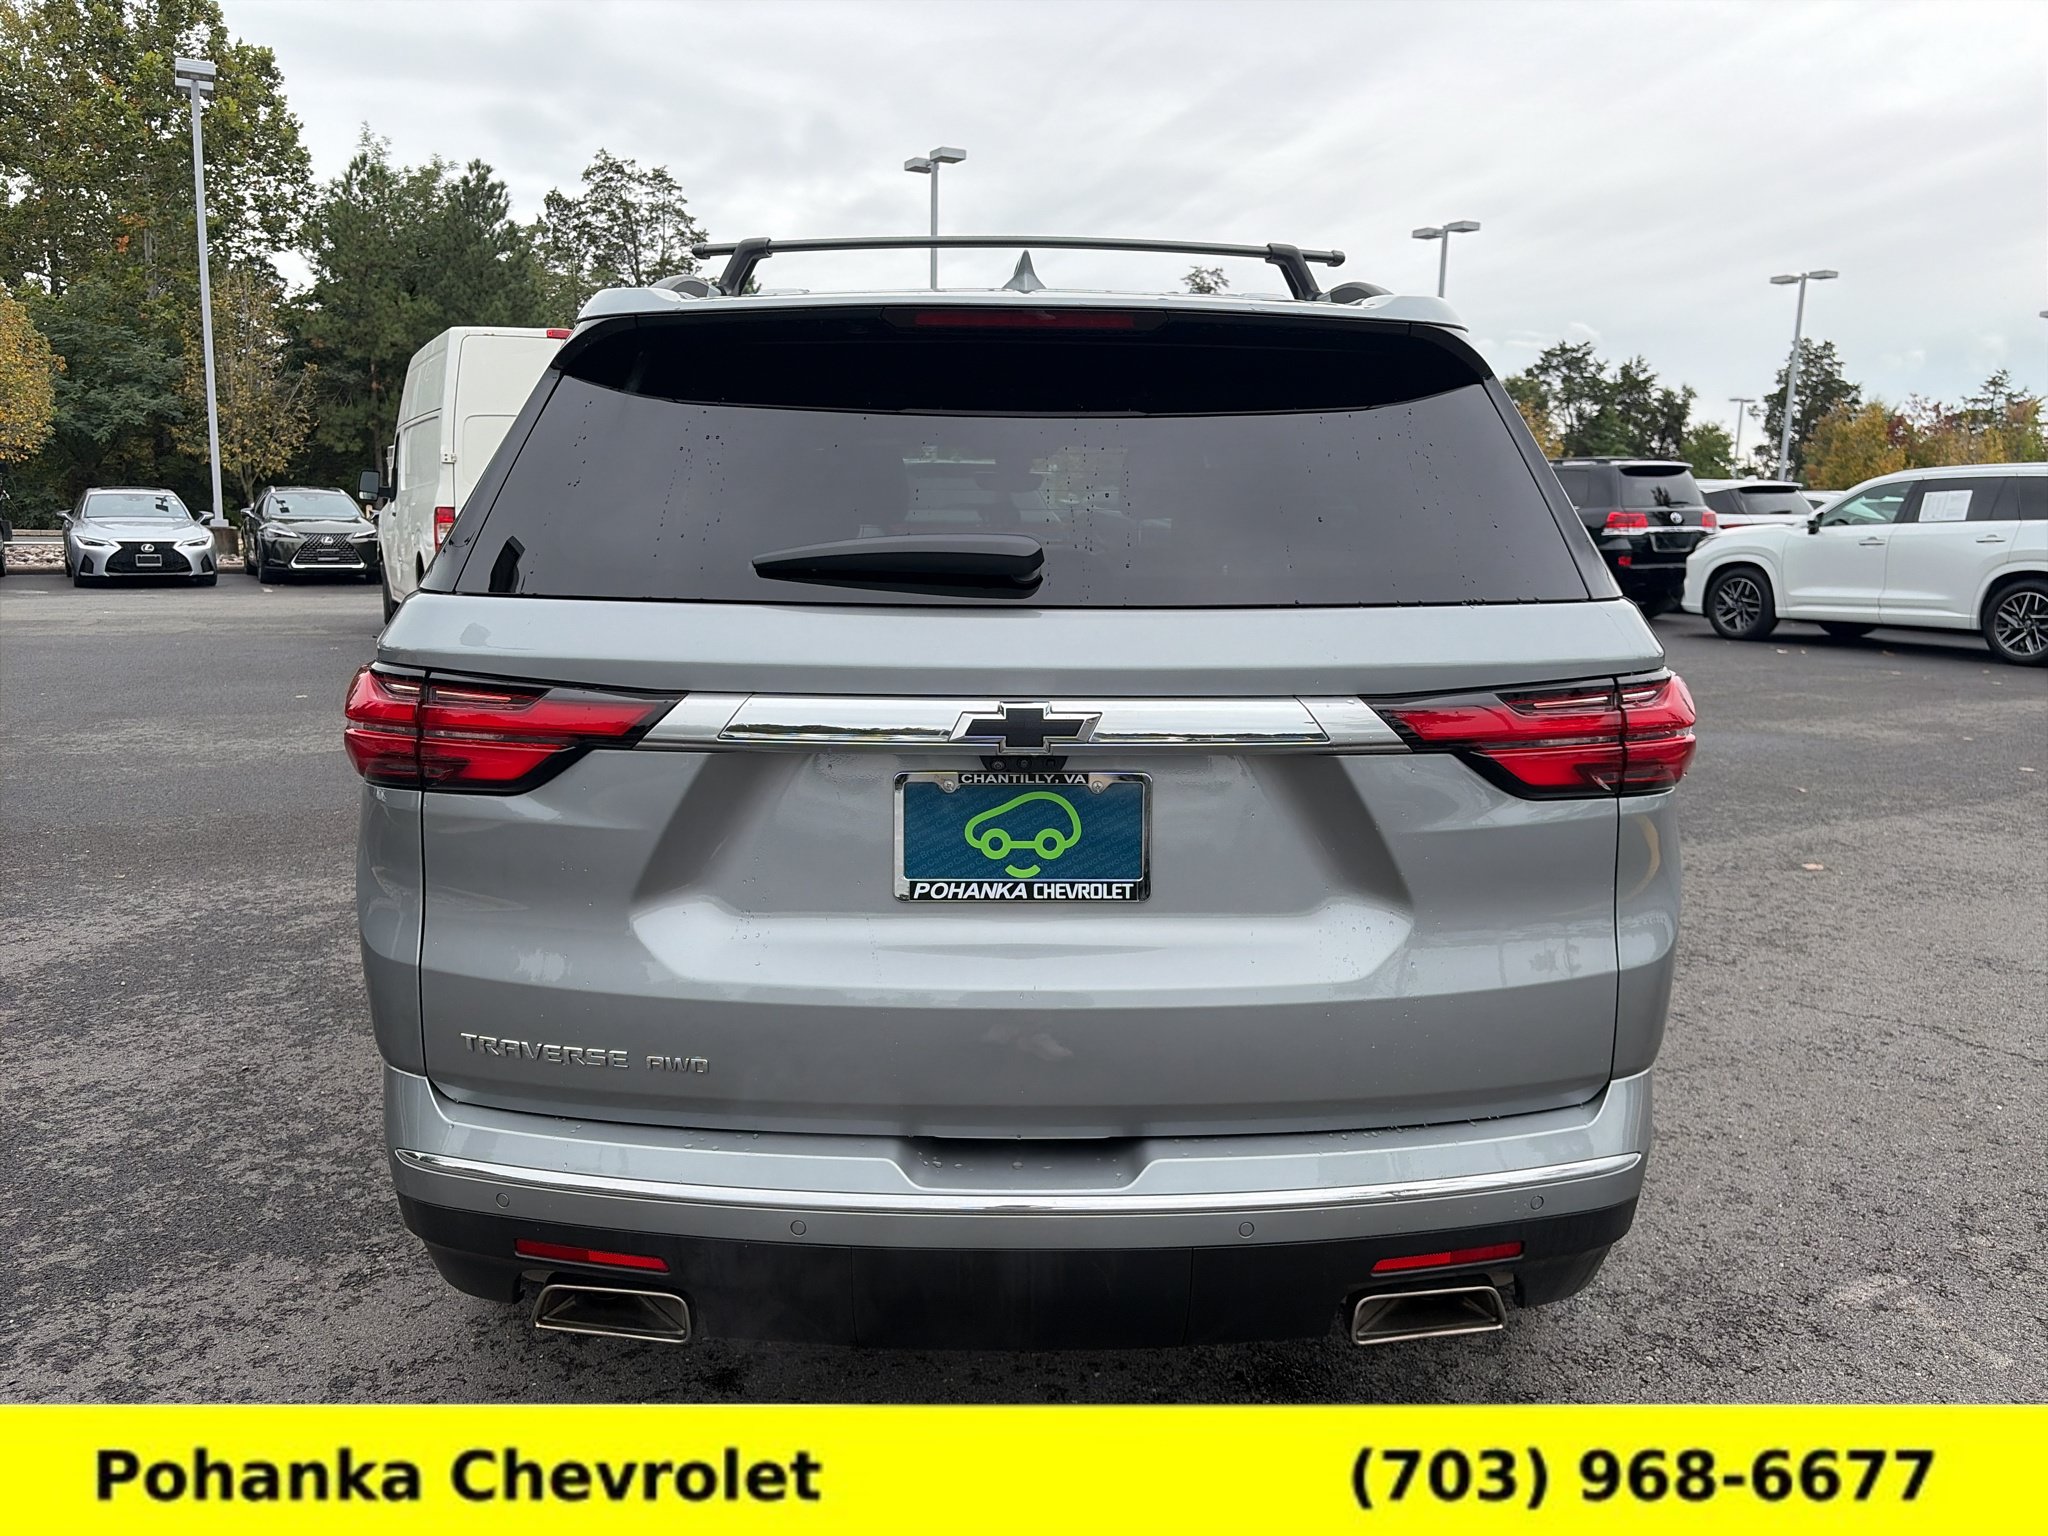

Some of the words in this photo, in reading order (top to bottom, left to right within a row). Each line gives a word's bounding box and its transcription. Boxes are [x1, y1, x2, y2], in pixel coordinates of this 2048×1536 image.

[960, 774, 1059, 784] CHANTILLY,
[1064, 774, 1087, 784] VA
[913, 882, 1027, 900] POHANKA
[1033, 883, 1134, 899] CHEVROLET
[460, 1032, 629, 1068] TRAVERSE
[645, 1054, 709, 1073] AWD
